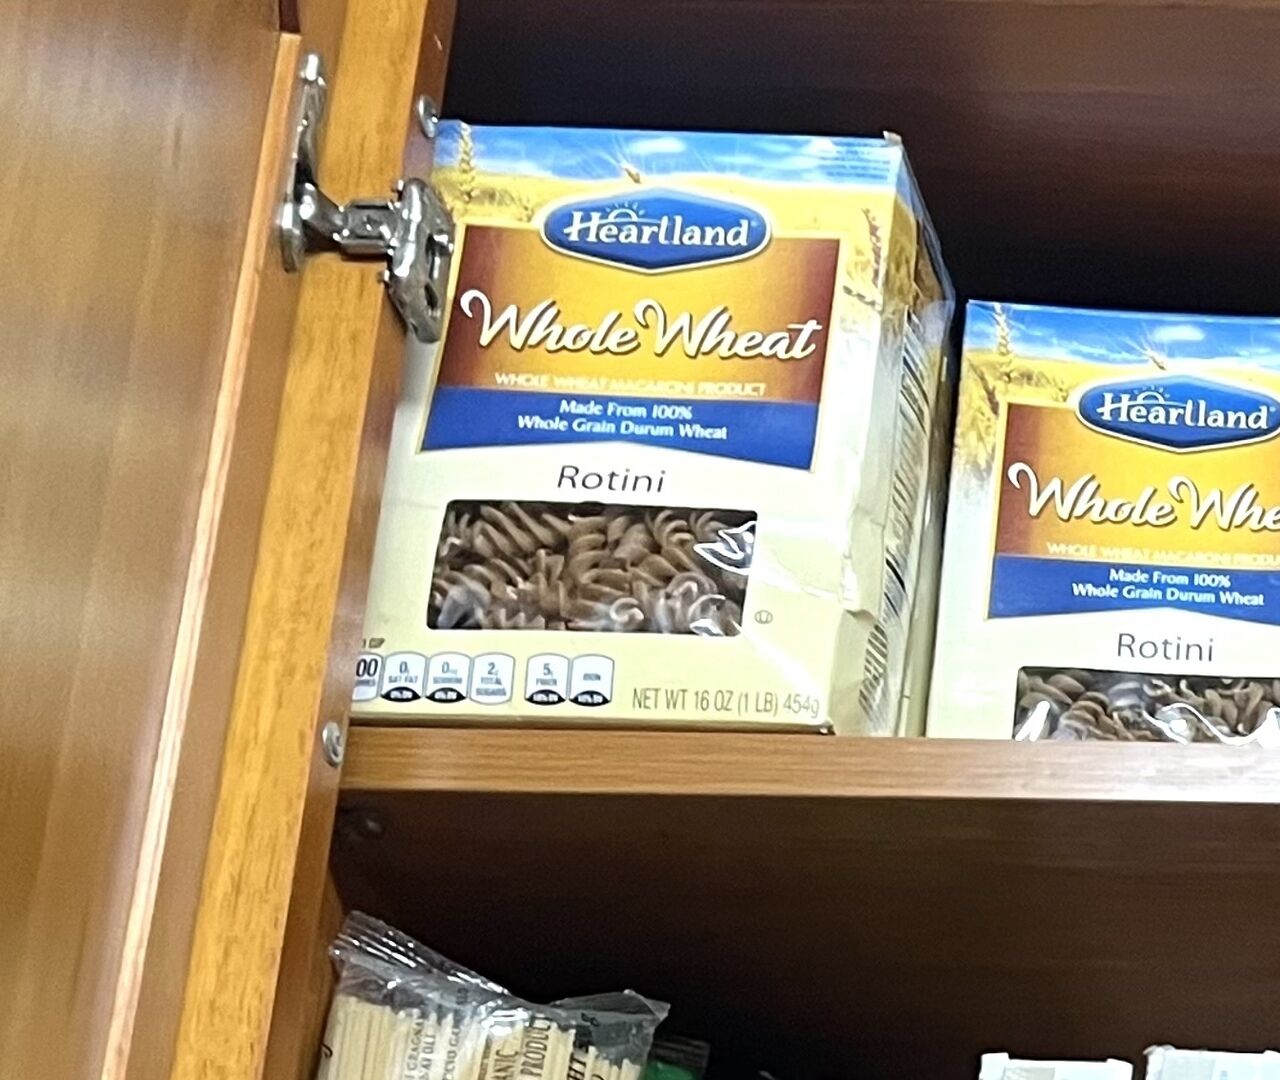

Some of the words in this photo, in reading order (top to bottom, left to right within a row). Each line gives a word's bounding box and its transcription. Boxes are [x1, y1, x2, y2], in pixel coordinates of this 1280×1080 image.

[563, 203, 751, 248] Heartland
[460, 290, 641, 355] Whole
[634, 298, 824, 361] Wheat
[495, 373, 547, 388] WHOLE
[553, 376, 608, 391] WHEAT
[697, 382, 766, 398] PRODUCT
[560, 399, 603, 416] Made
[607, 402, 647, 418] From
[652, 404, 693, 420] 100%
[1097, 391, 1269, 430] Heartland
[517, 415, 569, 433] Whole
[571, 418, 616, 435] Grain
[620, 421, 675, 438] Durum
[679, 424, 728, 441] Wheat
[557, 465, 667, 494] Rotini
[1008, 463, 1178, 526] Whole
[1047, 542, 1096, 556] WHOLE
[1101, 545, 1152, 560] WHEAT
[1109, 569, 1150, 584] Made
[1153, 571, 1189, 586] From
[1194, 573, 1231, 588] 100%
[1072, 583, 1118, 599] Whole
[1122, 585, 1163, 601] Grain
[1166, 588, 1216, 604] Durum
[1220, 590, 1264, 606] Wheat
[1117, 633, 1215, 662] Rotini
[355, 658, 379, 678] 00
[632, 690, 661, 711] NET
[665, 691, 689, 712] WT
[693, 692, 712, 712] 16
[715, 692, 735, 713] OZ
[738, 692, 752, 716] (1
[755, 692, 779, 716] LB)
[783, 696, 820, 721] 454g
